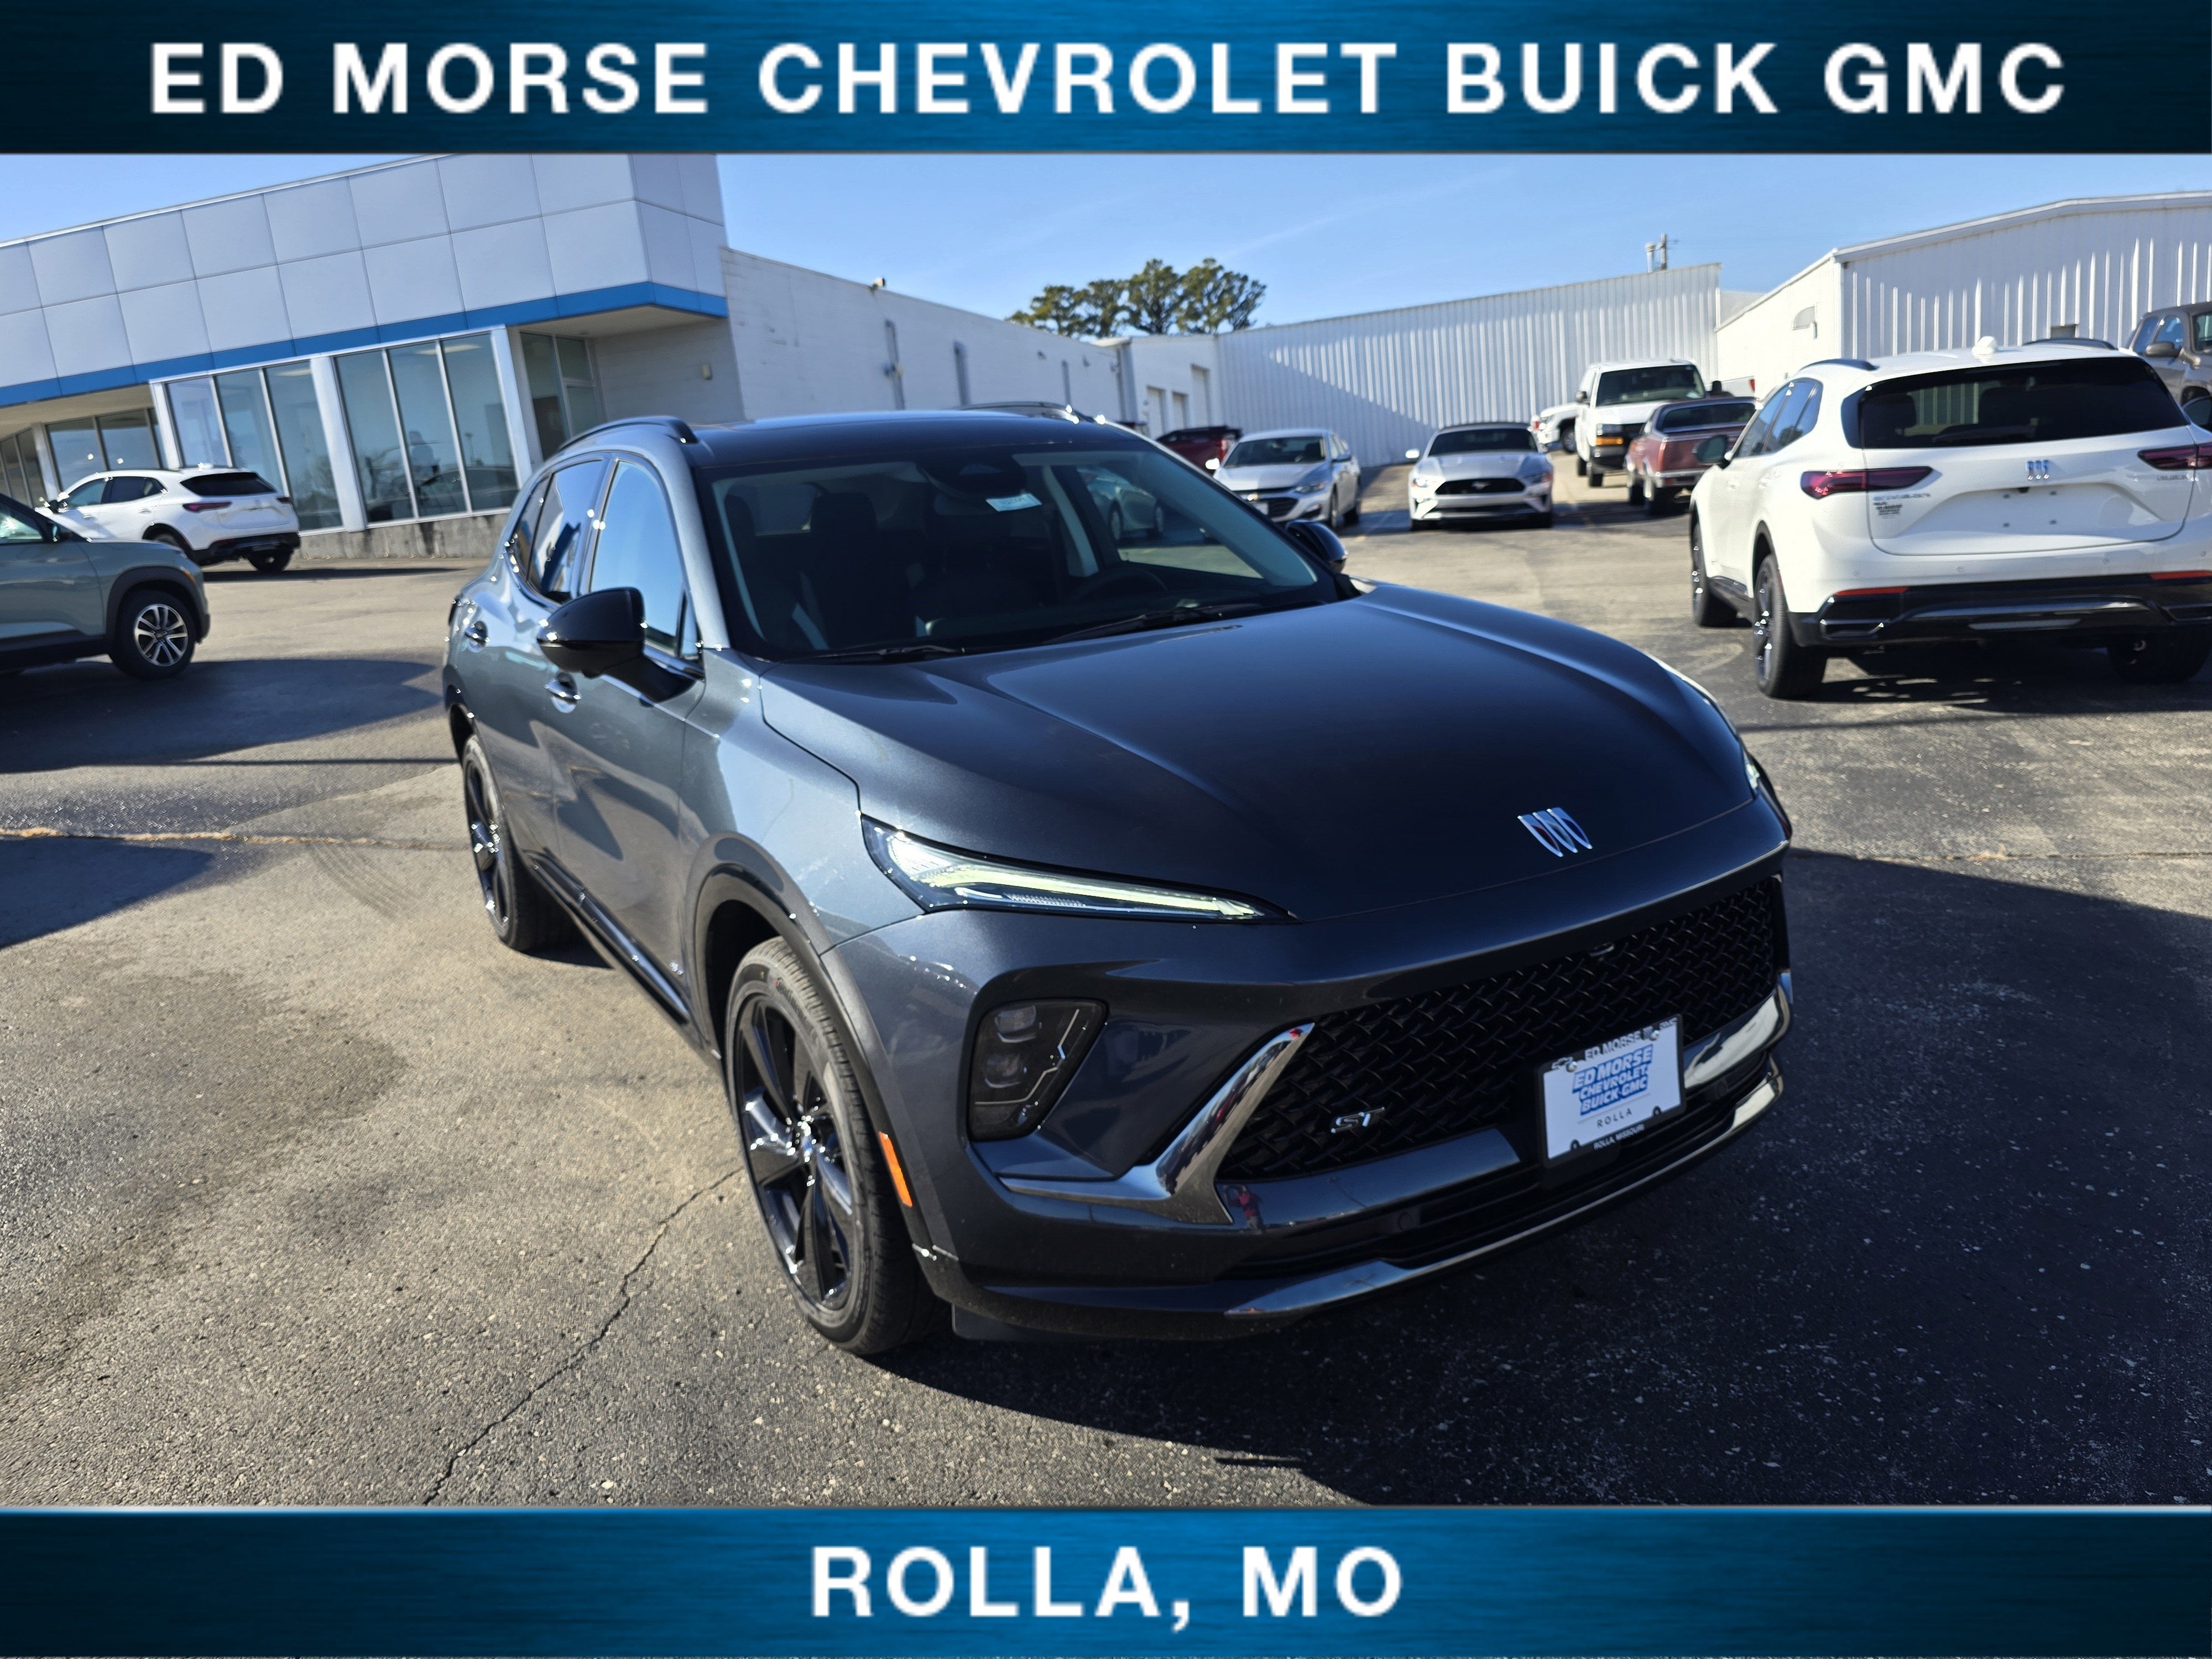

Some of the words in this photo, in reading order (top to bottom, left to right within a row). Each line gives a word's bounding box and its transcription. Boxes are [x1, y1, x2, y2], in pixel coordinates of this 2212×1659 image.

[1585, 1046, 1600, 1060] ED
[1602, 1031, 1641, 1054] MORSE
[1573, 1066, 1597, 1091] ED
[1597, 1045, 1653, 1081] MORSE
[1579, 1063, 1648, 1100] CHEVROLET
[1580, 1087, 1620, 1114] BUICK
[1621, 1075, 1647, 1097] GMC
[1597, 1108, 1632, 1128] ROLLA
